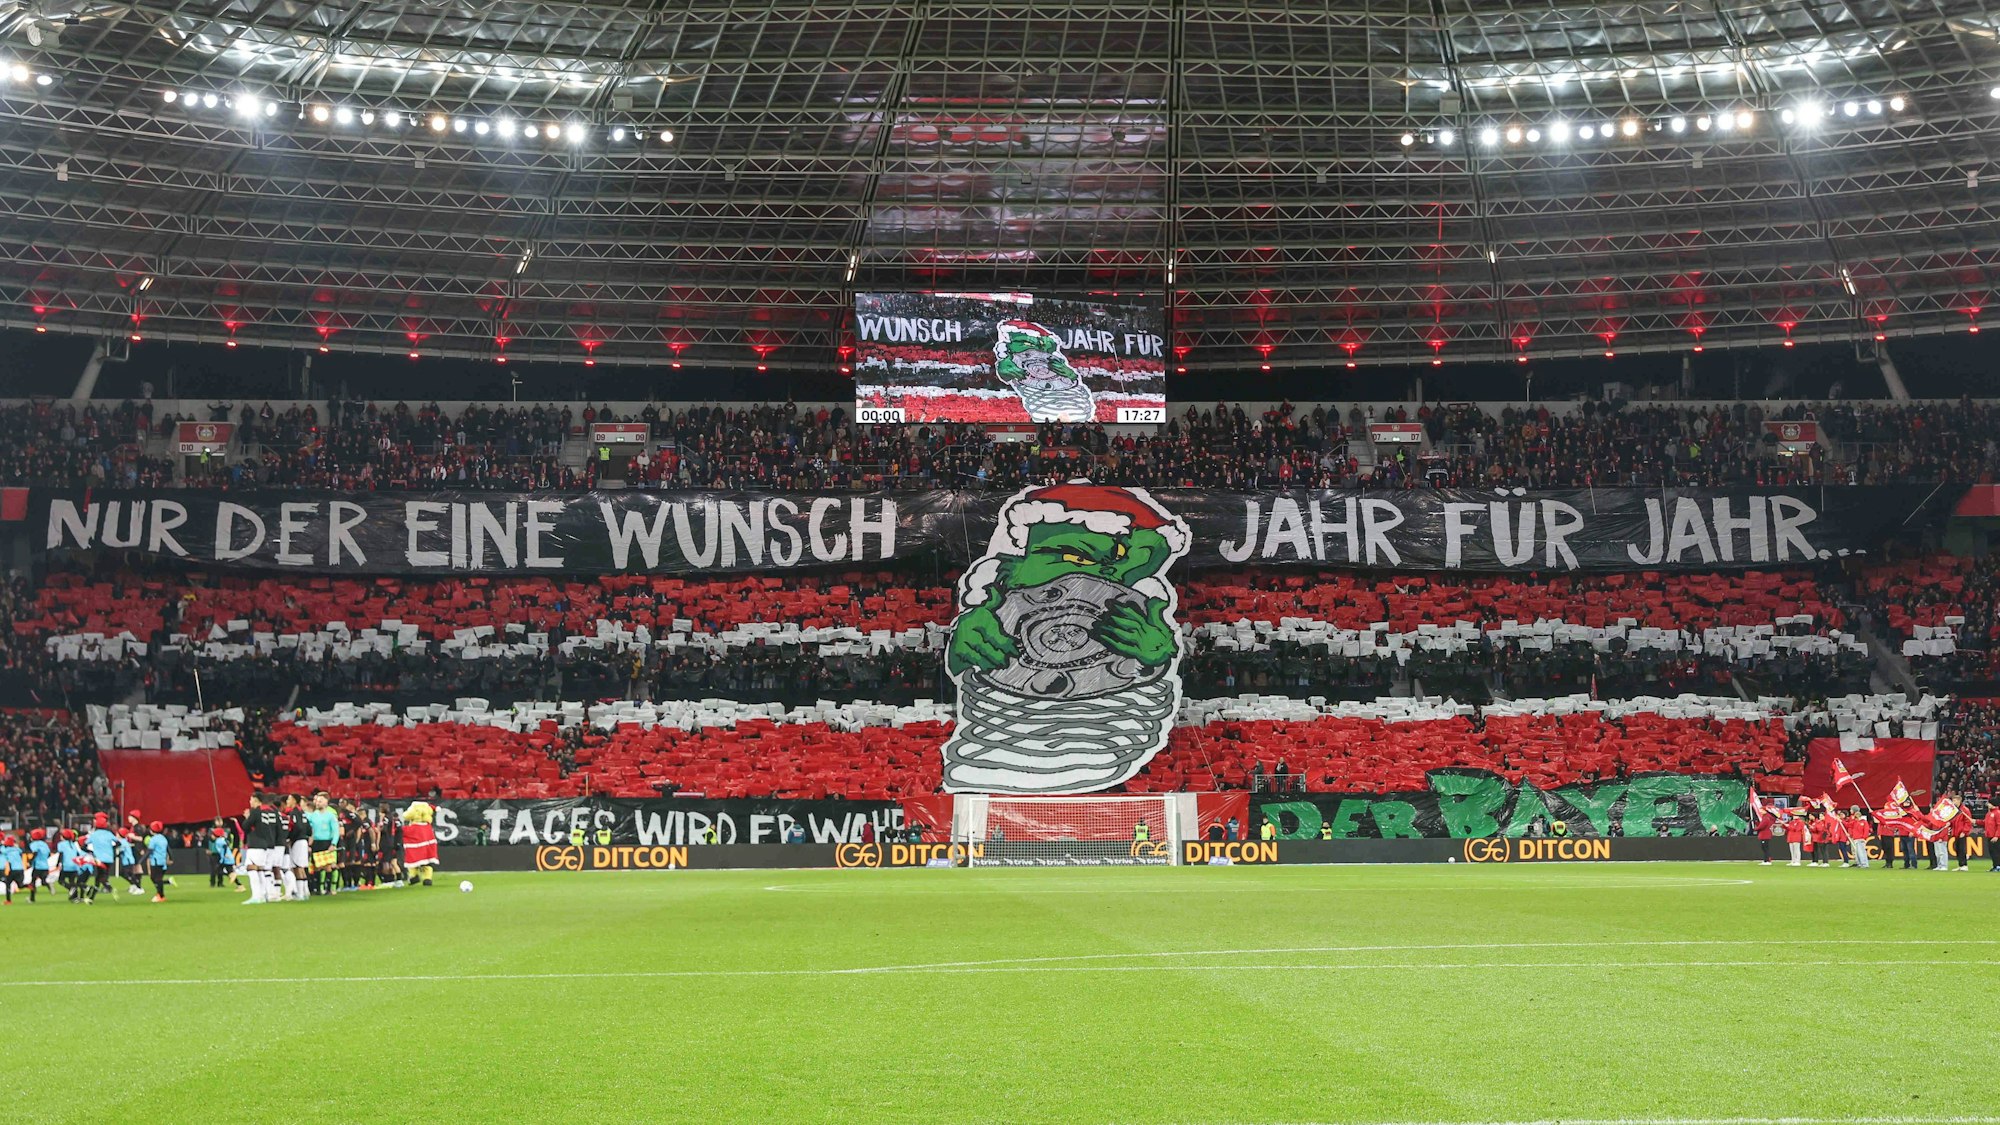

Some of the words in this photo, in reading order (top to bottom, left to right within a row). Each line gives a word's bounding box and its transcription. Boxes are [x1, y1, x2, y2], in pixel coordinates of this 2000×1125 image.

[857, 315, 962, 342] WUNSCH
[1061, 329, 1115, 353] JAHR
[1124, 329, 1164, 357] FÜR
[861, 410, 900, 421] 00:00
[1125, 410, 1160, 421] 17:27
[596, 433, 605, 441] D9
[635, 433, 644, 441] D9
[1411, 433, 1419, 441] D7
[46, 498, 190, 556] NUR
[214, 500, 368, 566] DER
[404, 501, 566, 570] EINE
[600, 497, 897, 569] WUNSCH
[1218, 497, 1404, 566] JAHR
[1443, 487, 1584, 571] FÜR
[1261, 799, 1425, 839] DER
[1431, 774, 1750, 838] BAYER
[594, 847, 687, 868] DITCON
[1186, 841, 1278, 863] DITCON
[1519, 839, 1610, 860] DITCON
